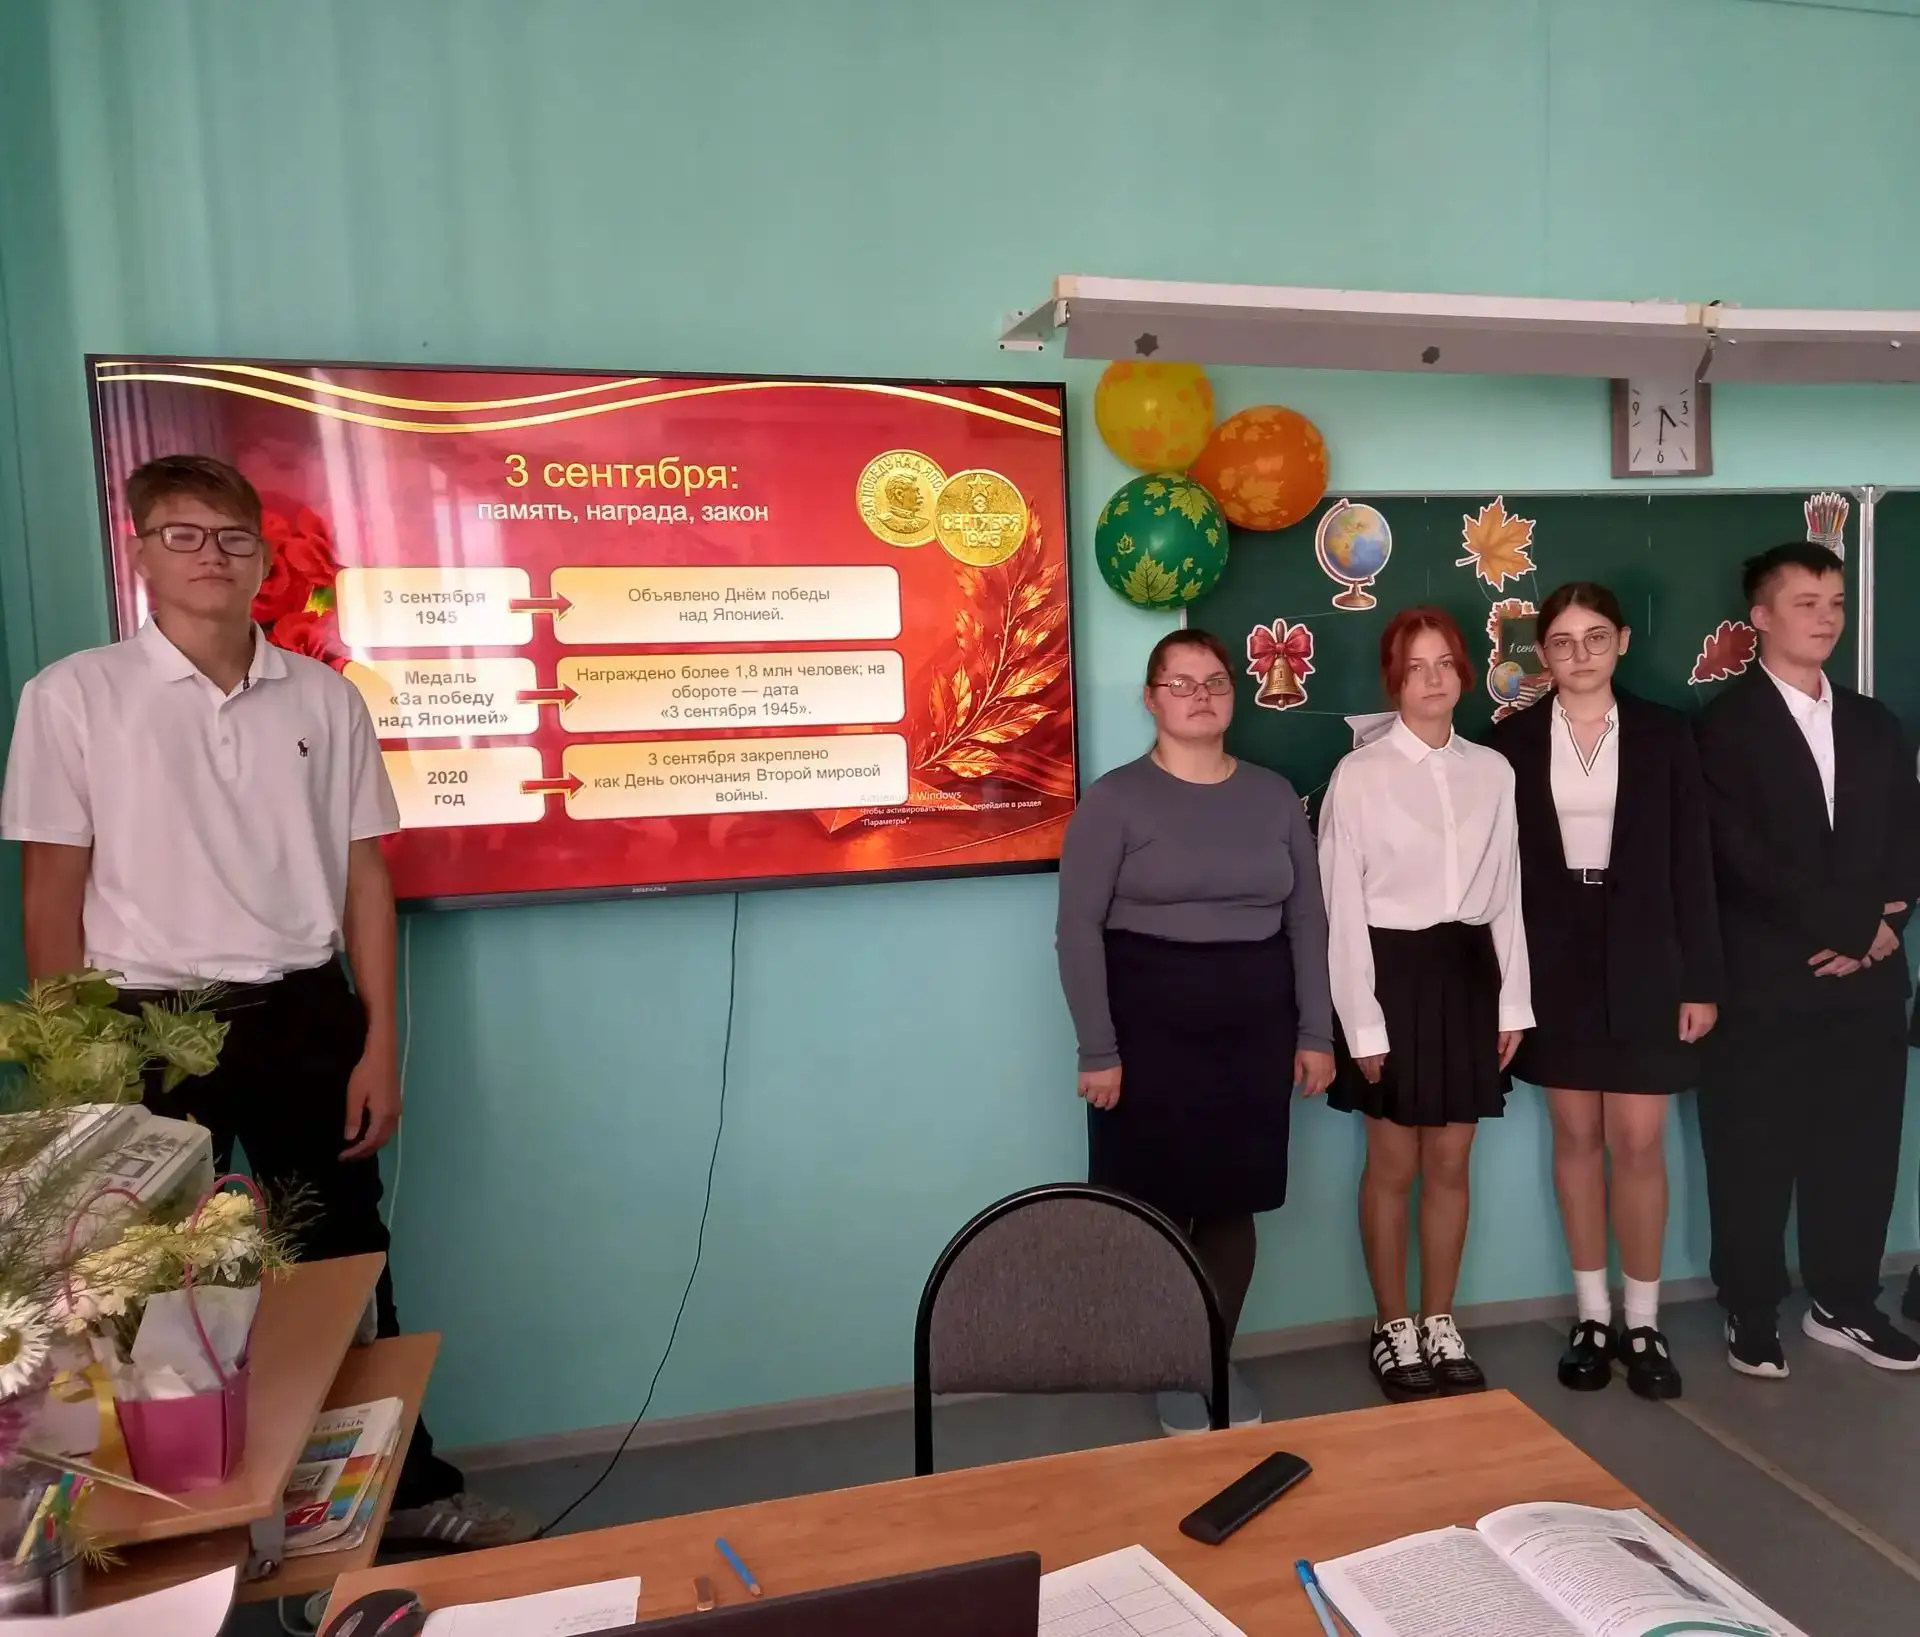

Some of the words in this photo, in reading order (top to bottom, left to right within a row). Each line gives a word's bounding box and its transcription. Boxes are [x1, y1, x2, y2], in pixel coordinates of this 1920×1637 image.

[1632, 402, 1640, 416] 9
[1681, 401, 1689, 415] 3
[1657, 450, 1665, 463] 6
[504, 454, 529, 487] 3
[543, 456, 739, 497] сентября:
[478, 503, 579, 524] память,
[586, 504, 695, 525] награда,
[701, 505, 769, 522] закон
[383, 590, 394, 604] 3
[400, 590, 486, 606] сентября
[628, 588, 720, 602] Объявлено
[725, 586, 766, 603] Днём
[772, 587, 830, 602] победы
[416, 610, 458, 624] 1945
[679, 610, 708, 623] над
[713, 608, 784, 622] Японией.
[405, 671, 477, 686] Медаль
[577, 667, 676, 684] Награждено
[681, 665, 729, 679] более
[735, 664, 758, 679] 1,8
[763, 667, 793, 677] млн
[798, 664, 863, 677] человек;
[868, 664, 885, 675] на
[390, 692, 422, 706] «За
[428, 690, 494, 708] победу
[672, 685, 737, 700] обороте
[763, 685, 799, 698] дата
[661, 705, 679, 718] «3
[684, 703, 756, 719] сентября
[763, 702, 812, 716] 1945».
[378, 716, 413, 728] над
[418, 710, 508, 726] Японией»
[648, 753, 658, 765] 3
[663, 750, 735, 766] сентября
[741, 749, 829, 764] закреплено
[427, 770, 468, 785] 2020
[594, 776, 620, 788] как
[625, 773, 664, 788] День
[669, 771, 751, 786] окончания
[757, 767, 812, 783] Второй
[817, 764, 881, 781] мировой
[434, 794, 465, 806] год
[716, 788, 768, 802] войны.
[917, 791, 962, 801] Windows
[300, 1505, 324, 1524] 7
